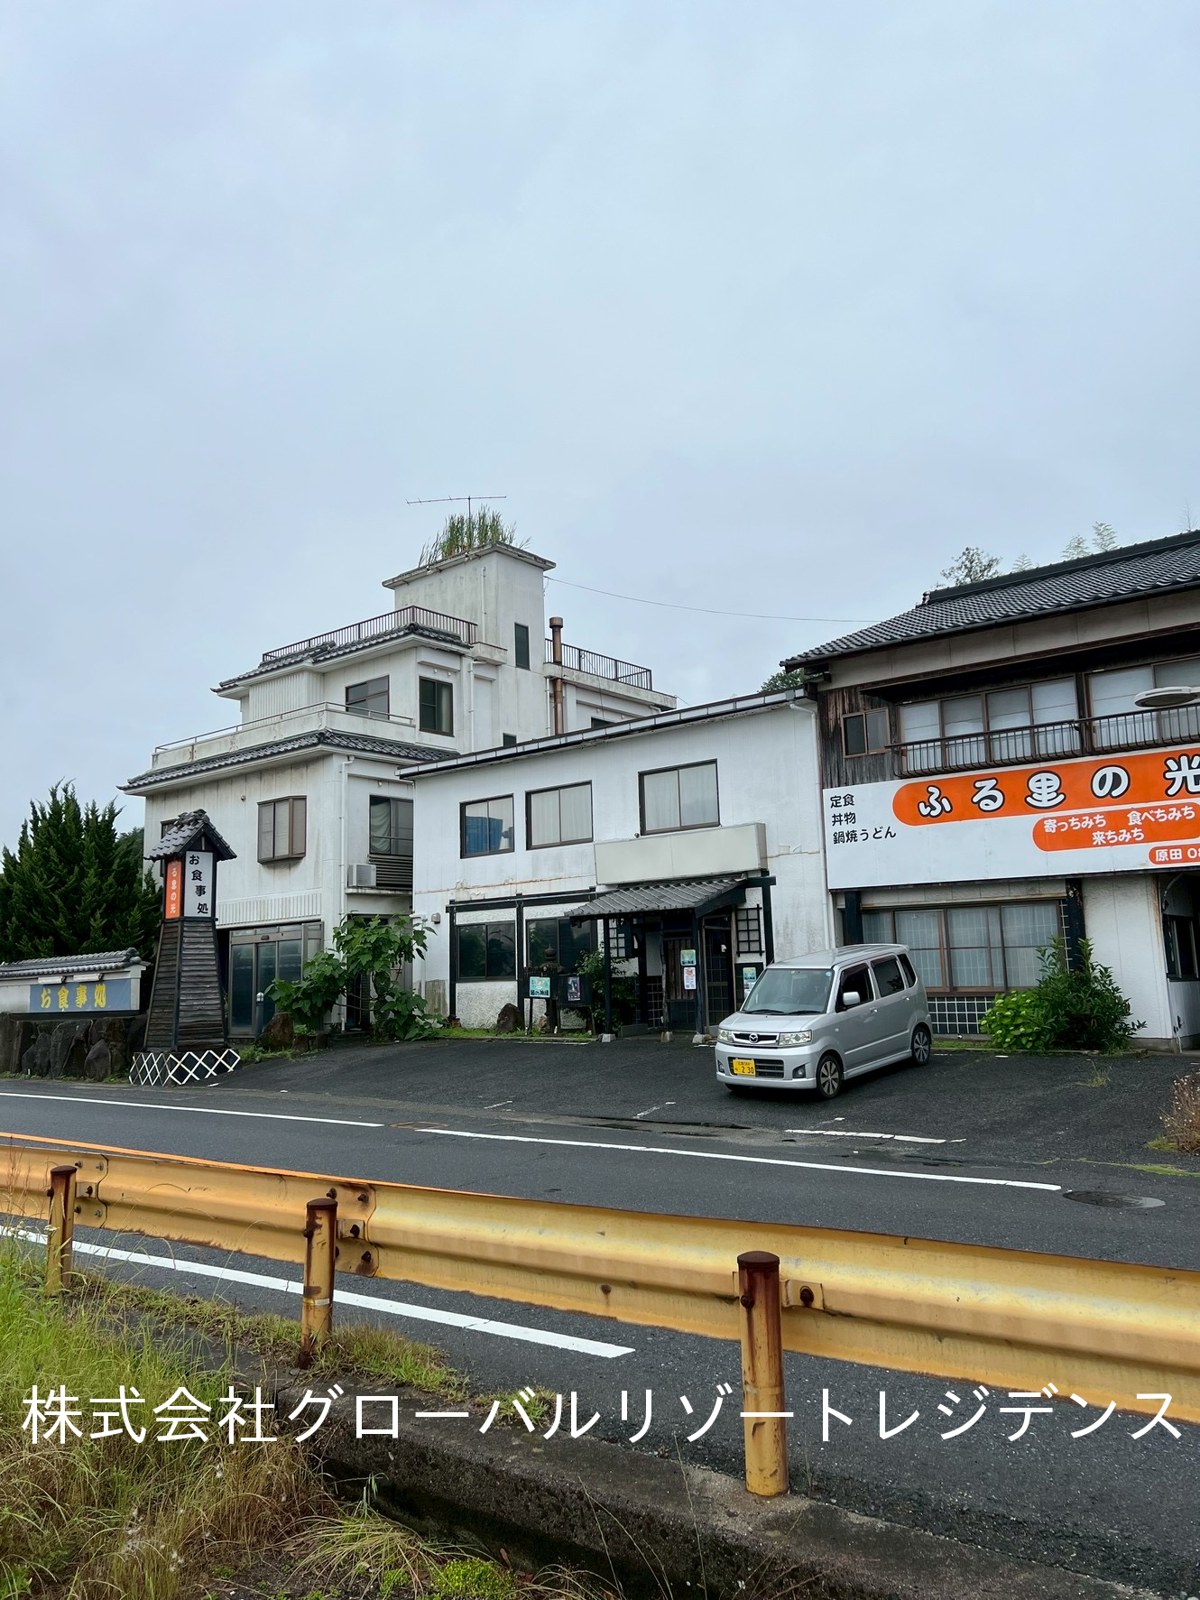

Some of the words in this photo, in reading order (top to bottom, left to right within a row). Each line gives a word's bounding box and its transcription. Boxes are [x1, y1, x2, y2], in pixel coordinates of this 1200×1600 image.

[830, 793, 855, 809] 定食
[831, 811, 857, 827] 丼物
[1043, 814, 1107, 834] 寄っちみち
[1127, 805, 1196, 826] 食べちみち
[833, 826, 897, 845] 鍋焼うどん
[1092, 827, 1145, 846] 来ちみち
[1155, 848, 1182, 862] 原田
[1187, 847, 1200, 860] 0
[188, 854, 209, 914] お食事処
